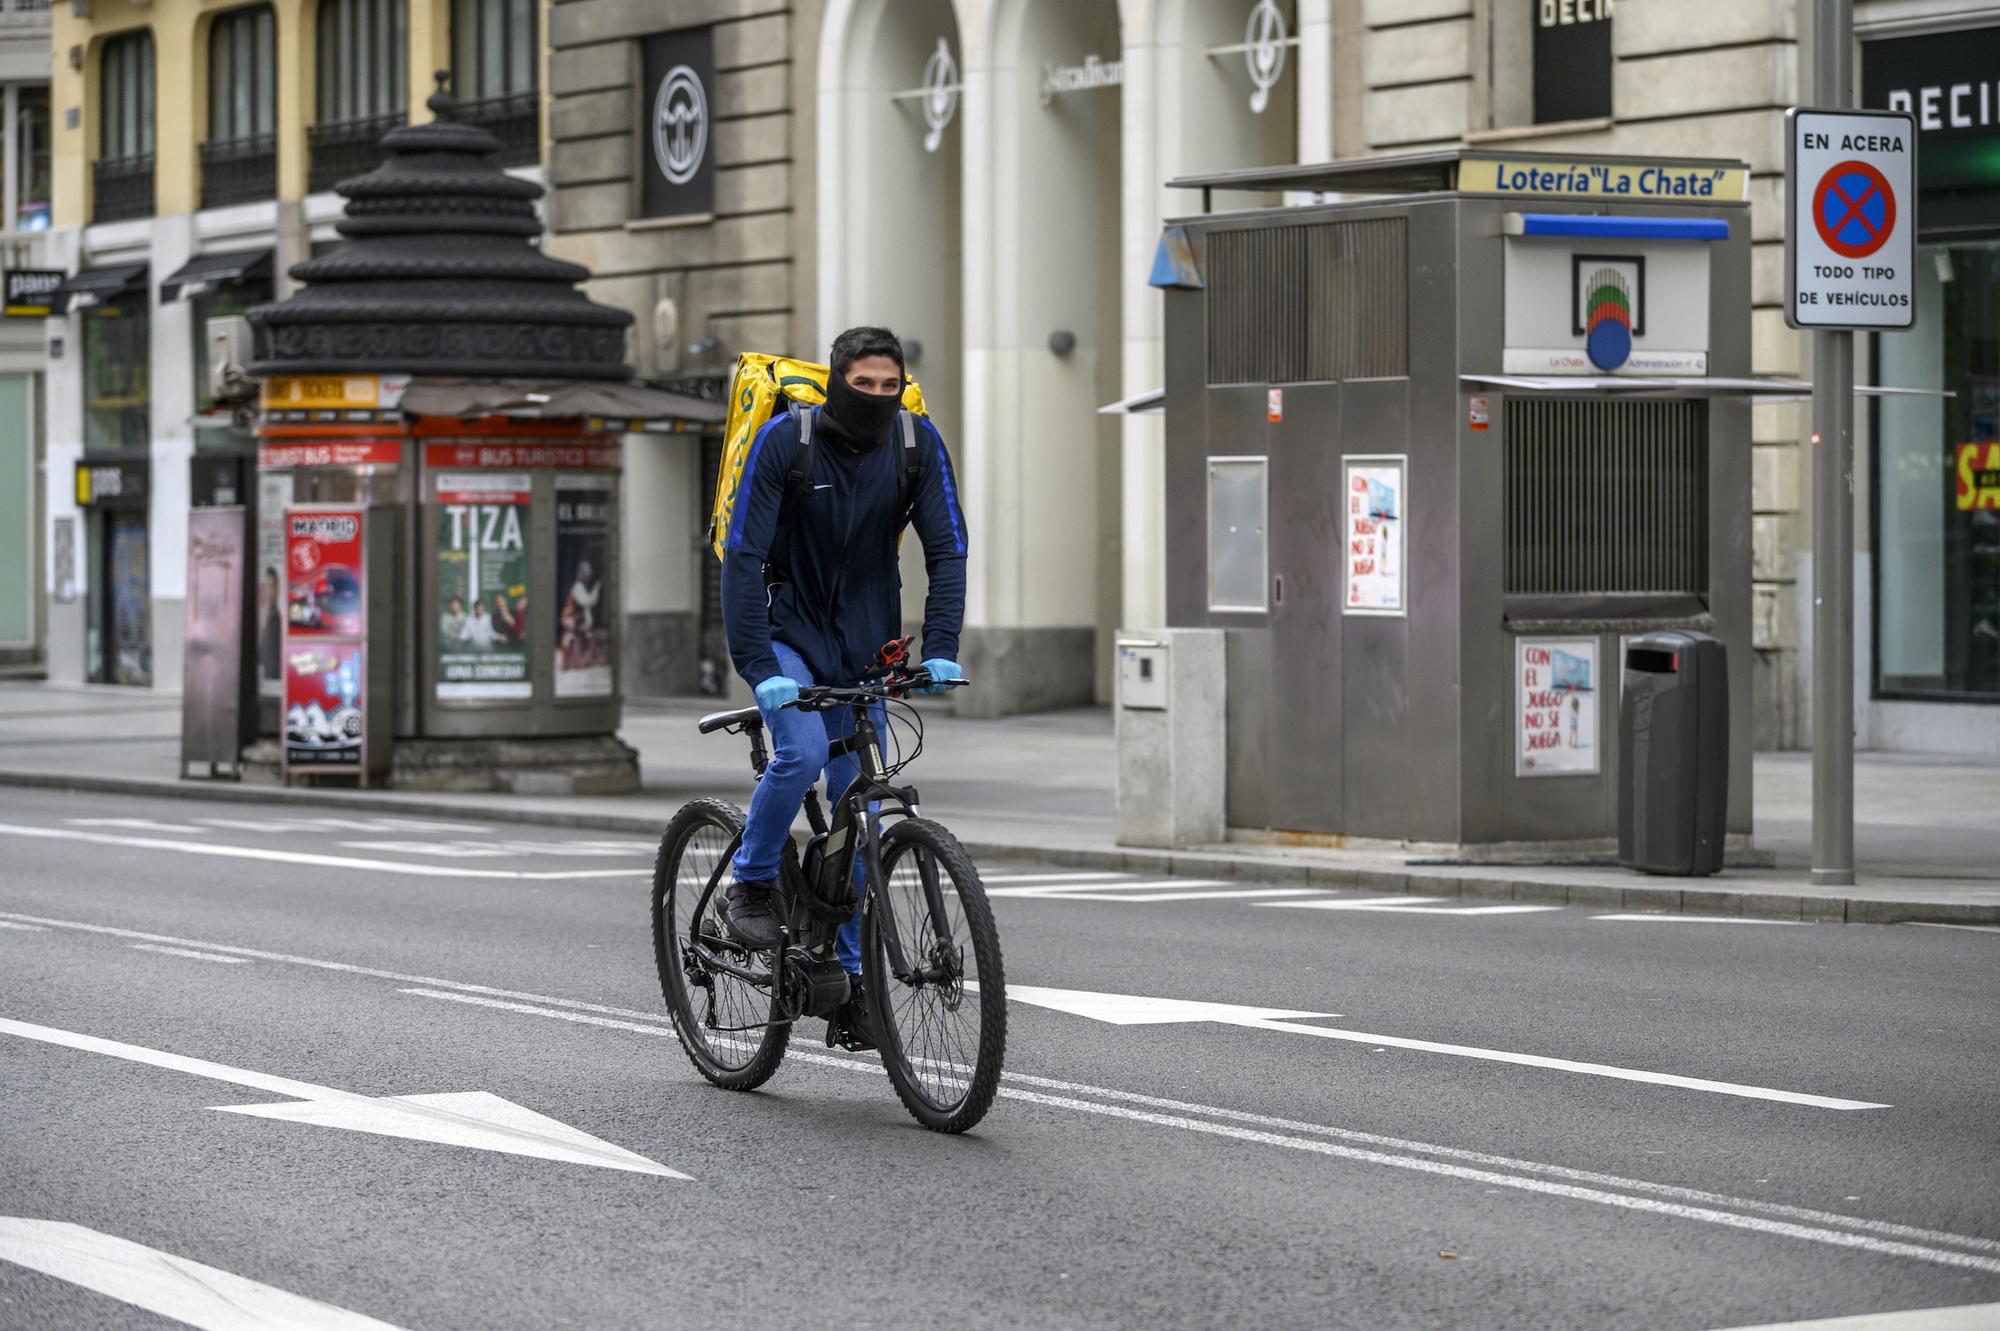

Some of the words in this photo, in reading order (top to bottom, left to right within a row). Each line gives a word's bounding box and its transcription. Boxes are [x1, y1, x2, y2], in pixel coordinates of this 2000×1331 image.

[1890, 81, 2000, 130] DECI
[1804, 134, 1829, 150] EN
[1841, 135, 1904, 152] ACERA
[1497, 164, 1590, 192] Lotería
[1814, 266, 1853, 279] TODO
[1862, 267, 1895, 280] TIPO
[1800, 292, 1818, 305] DE
[1826, 290, 1909, 306] VEHÍCULOS
[447, 505, 523, 550] TIZA
[1526, 647, 1550, 665] CON
[1525, 668, 1537, 687] EL
[1526, 691, 1563, 708] JUEGO
[1525, 712, 1543, 729] NO
[1549, 711, 1559, 728] SE
[1526, 731, 1562, 751] JUEGA
